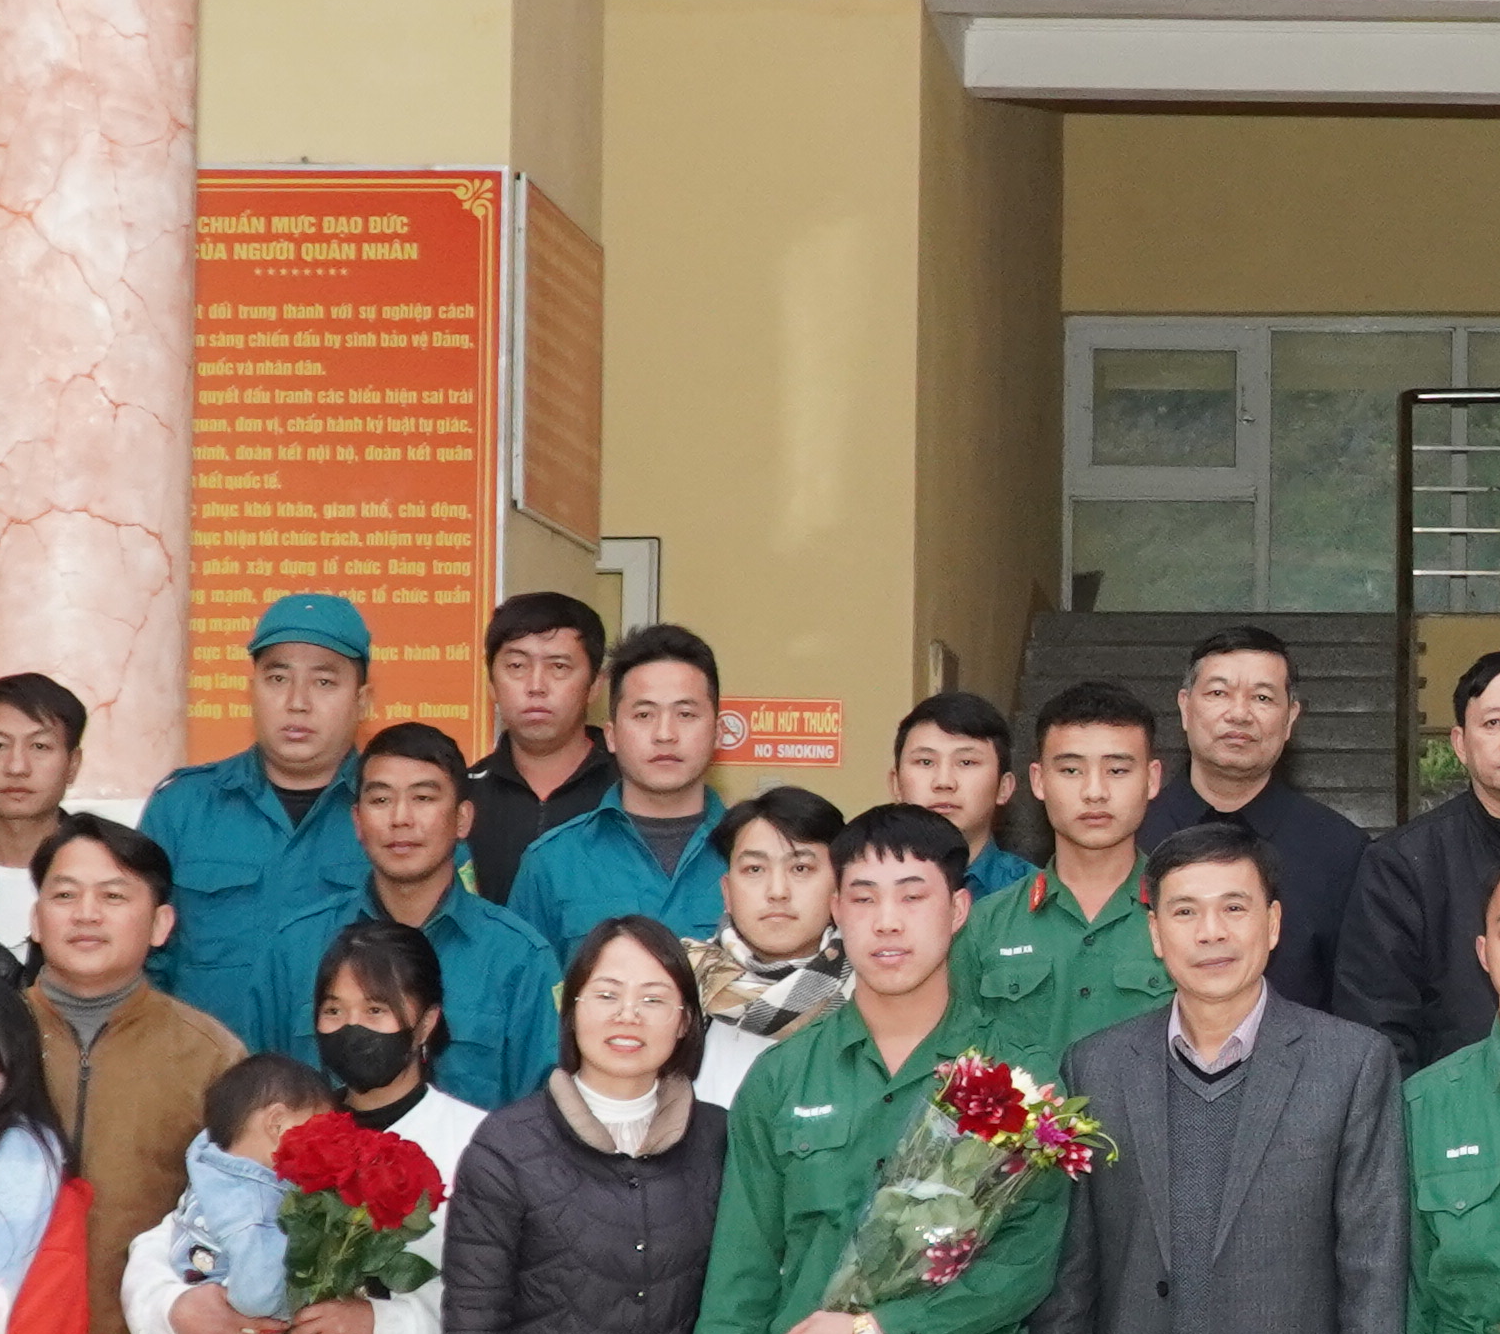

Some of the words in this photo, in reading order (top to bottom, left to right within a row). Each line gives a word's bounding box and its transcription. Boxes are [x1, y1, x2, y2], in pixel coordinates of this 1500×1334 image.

[272, 215, 316, 237] MỰC
[322, 216, 362, 237] ĐẠO
[368, 213, 409, 233] ĐỨC
[233, 239, 294, 260] NGƯỜI
[301, 239, 356, 262] QUÂN
[362, 239, 418, 260] NHÂN
[238, 305, 276, 320] trung
[439, 303, 474, 319] cách
[275, 389, 312, 404] tranh
[751, 704, 774, 732] CẤM
[778, 706, 800, 732] HÚT
[755, 744, 772, 758] NO
[777, 744, 834, 759] SMOKING
